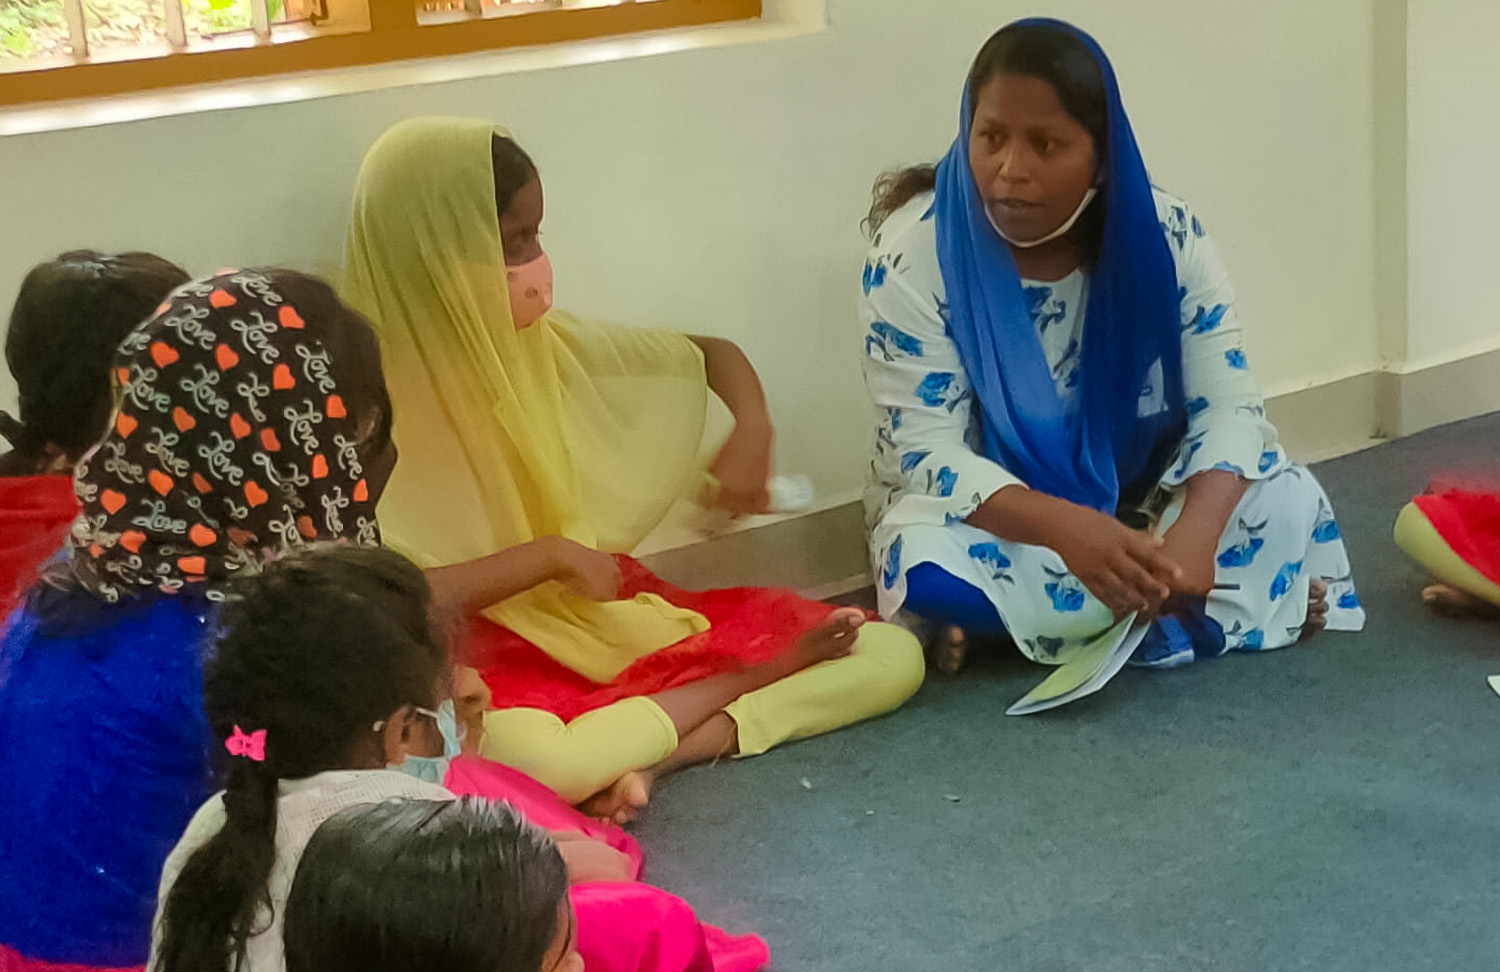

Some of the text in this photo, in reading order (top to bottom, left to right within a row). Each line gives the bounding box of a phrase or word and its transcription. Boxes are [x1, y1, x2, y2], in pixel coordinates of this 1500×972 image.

[164, 304, 216, 350] Love
[230, 311, 280, 365] Love
[123, 364, 171, 413] Love
[180, 364, 229, 418] Love
[283, 399, 322, 455] Love
[197, 431, 244, 486] Love
[131, 498, 187, 531] Love
